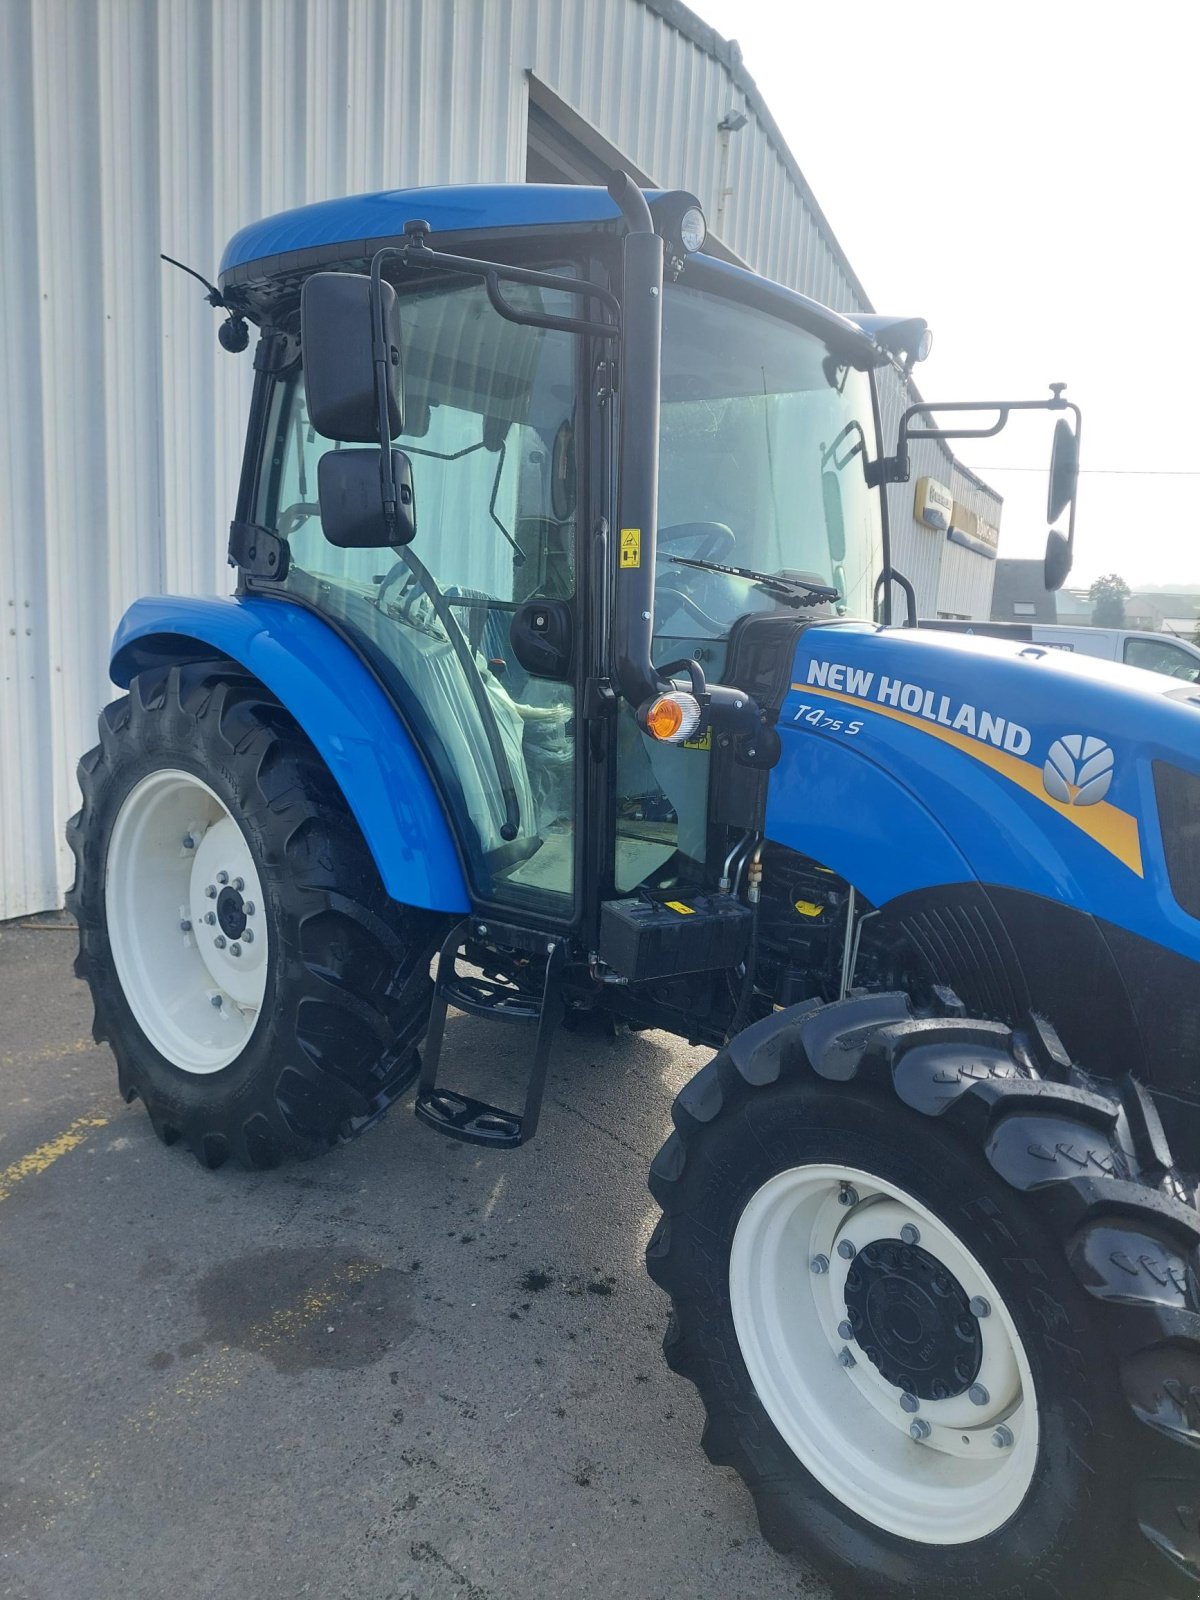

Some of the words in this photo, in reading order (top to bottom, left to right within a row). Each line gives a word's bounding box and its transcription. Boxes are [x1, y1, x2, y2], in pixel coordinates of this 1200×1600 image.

[808, 659, 874, 697] NEW
[877, 676, 1032, 756] HOLLAND
[844, 721, 864, 735] S
